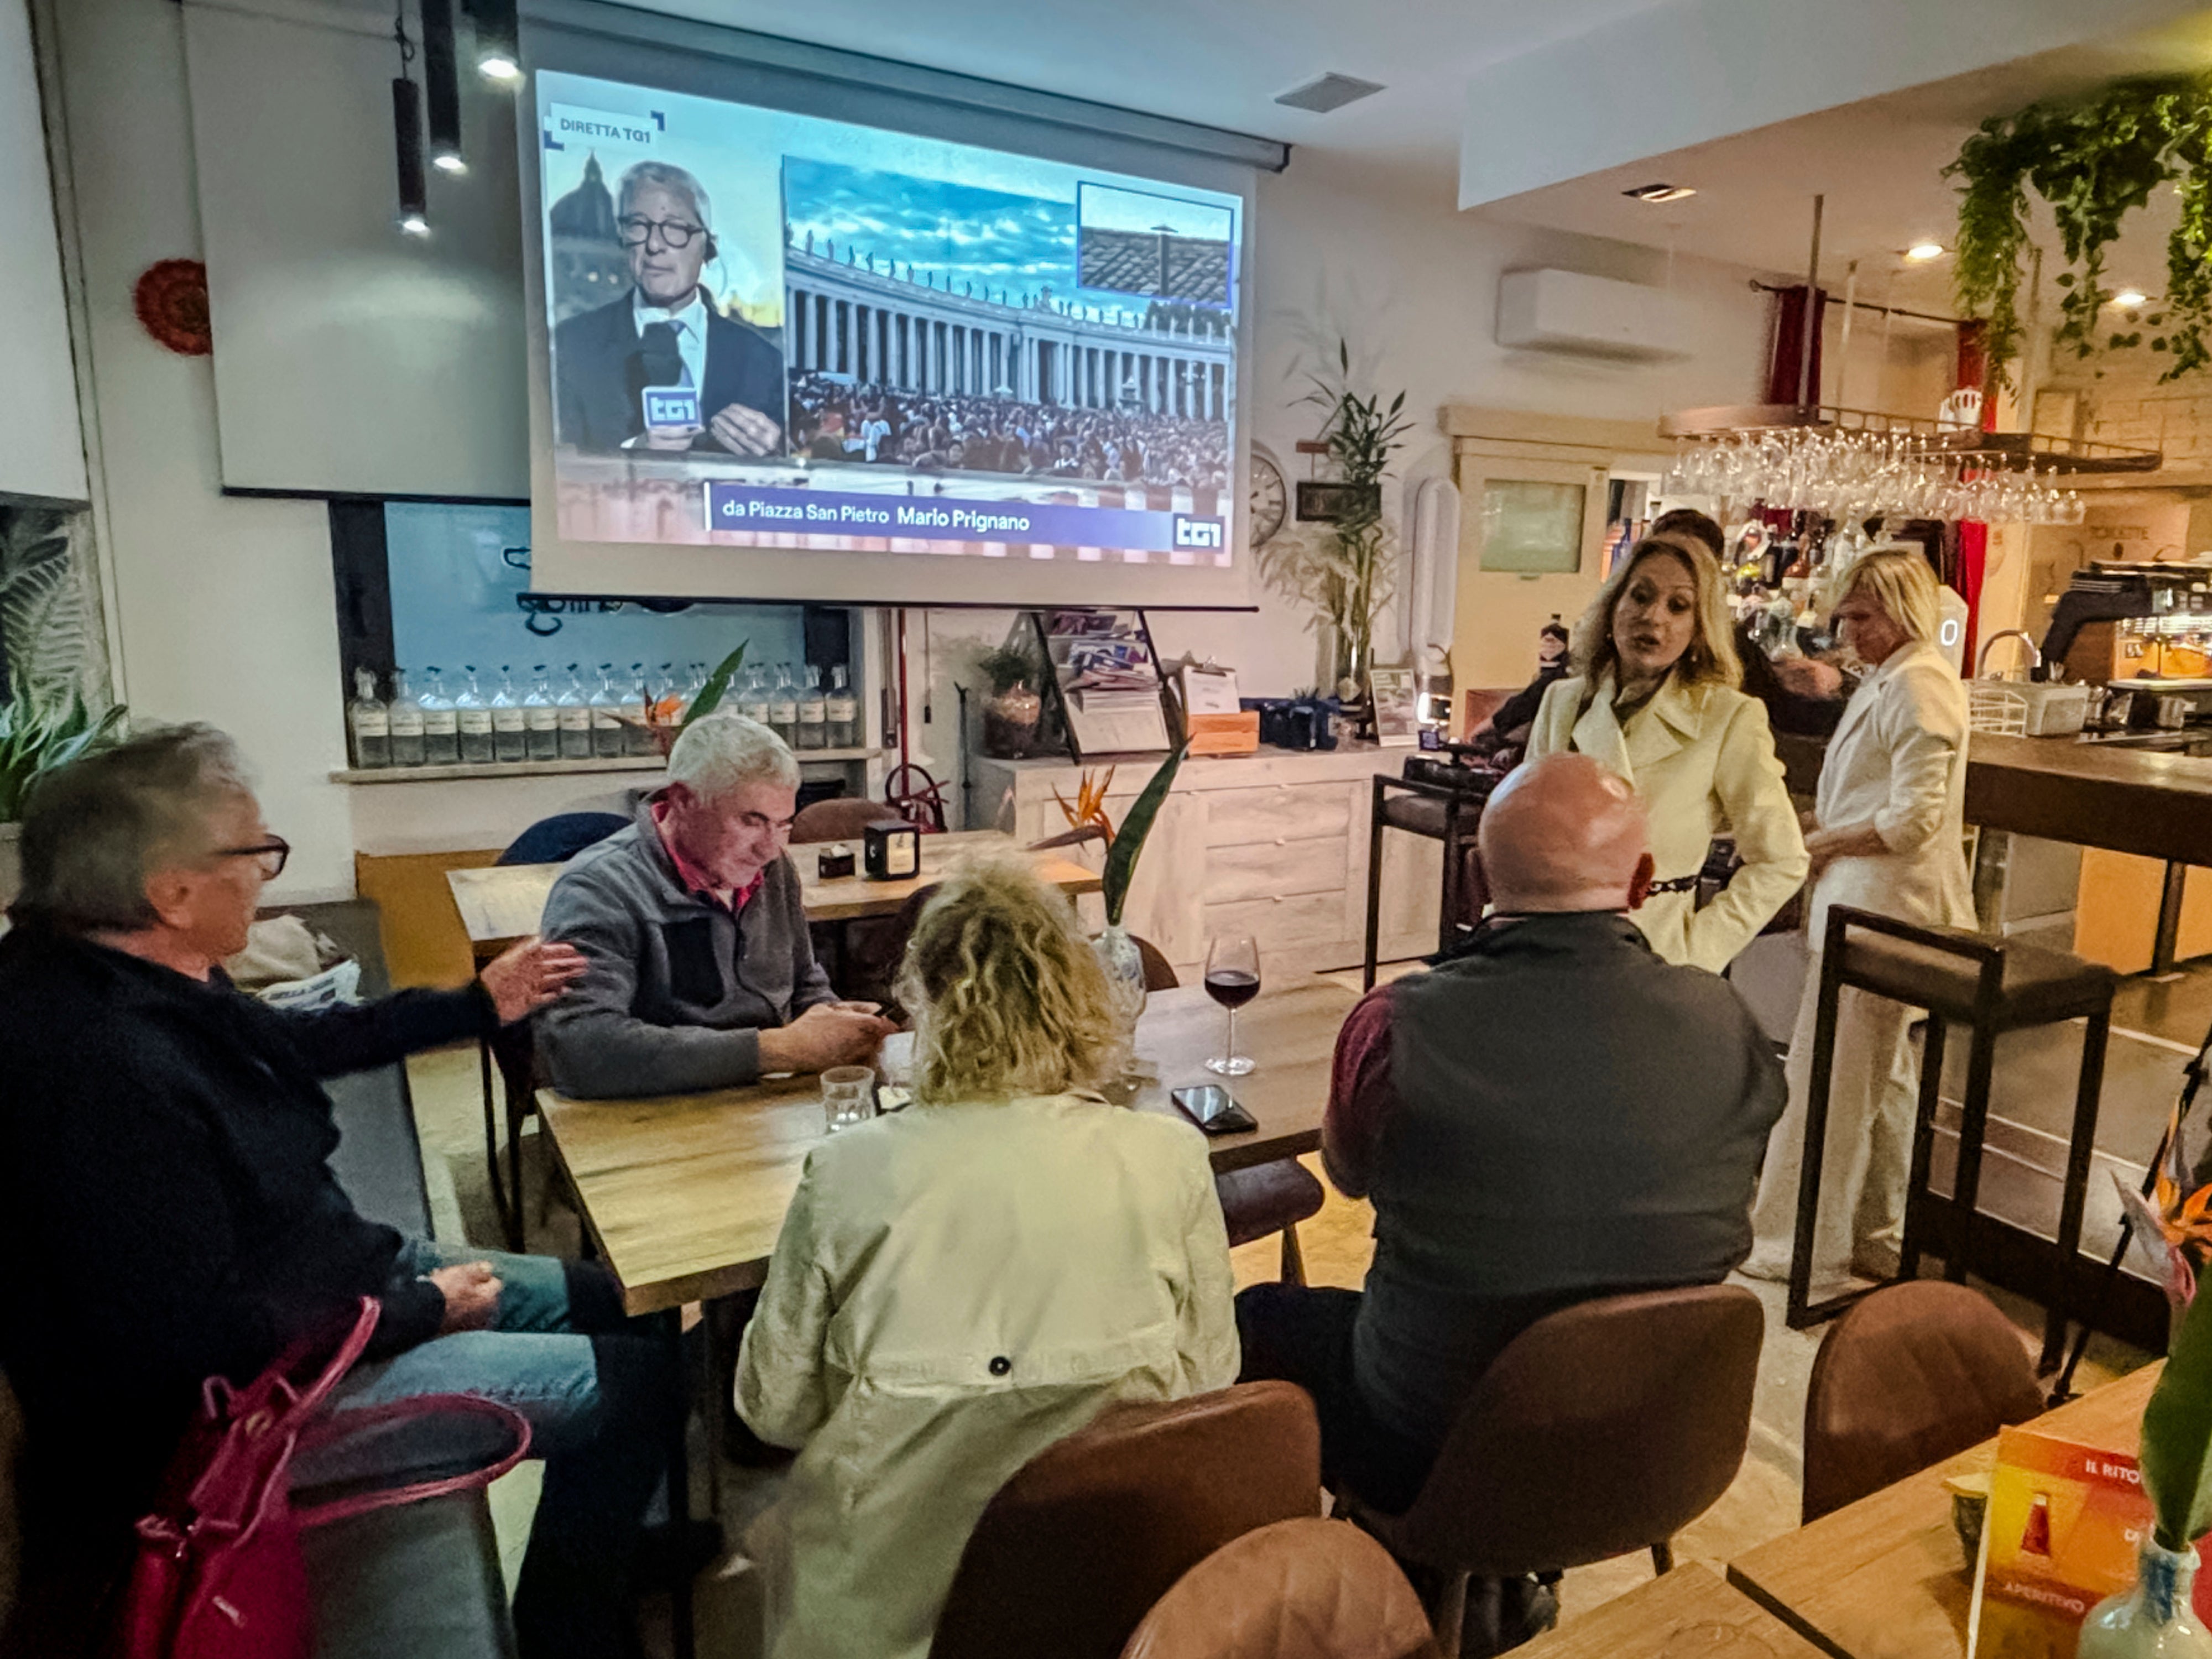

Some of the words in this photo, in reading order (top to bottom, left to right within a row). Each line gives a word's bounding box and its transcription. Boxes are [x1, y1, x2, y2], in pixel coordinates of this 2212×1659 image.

[560, 117, 620, 138] DIRETTA
[623, 127, 650, 143] TG1
[722, 499, 745, 516] da
[749, 501, 803, 519] Piazza
[806, 504, 837, 521] San
[841, 505, 889, 523] Pietro
[898, 505, 950, 526] Mario
[952, 509, 1030, 533] Prignano
[2085, 1458, 2098, 1474] IL
